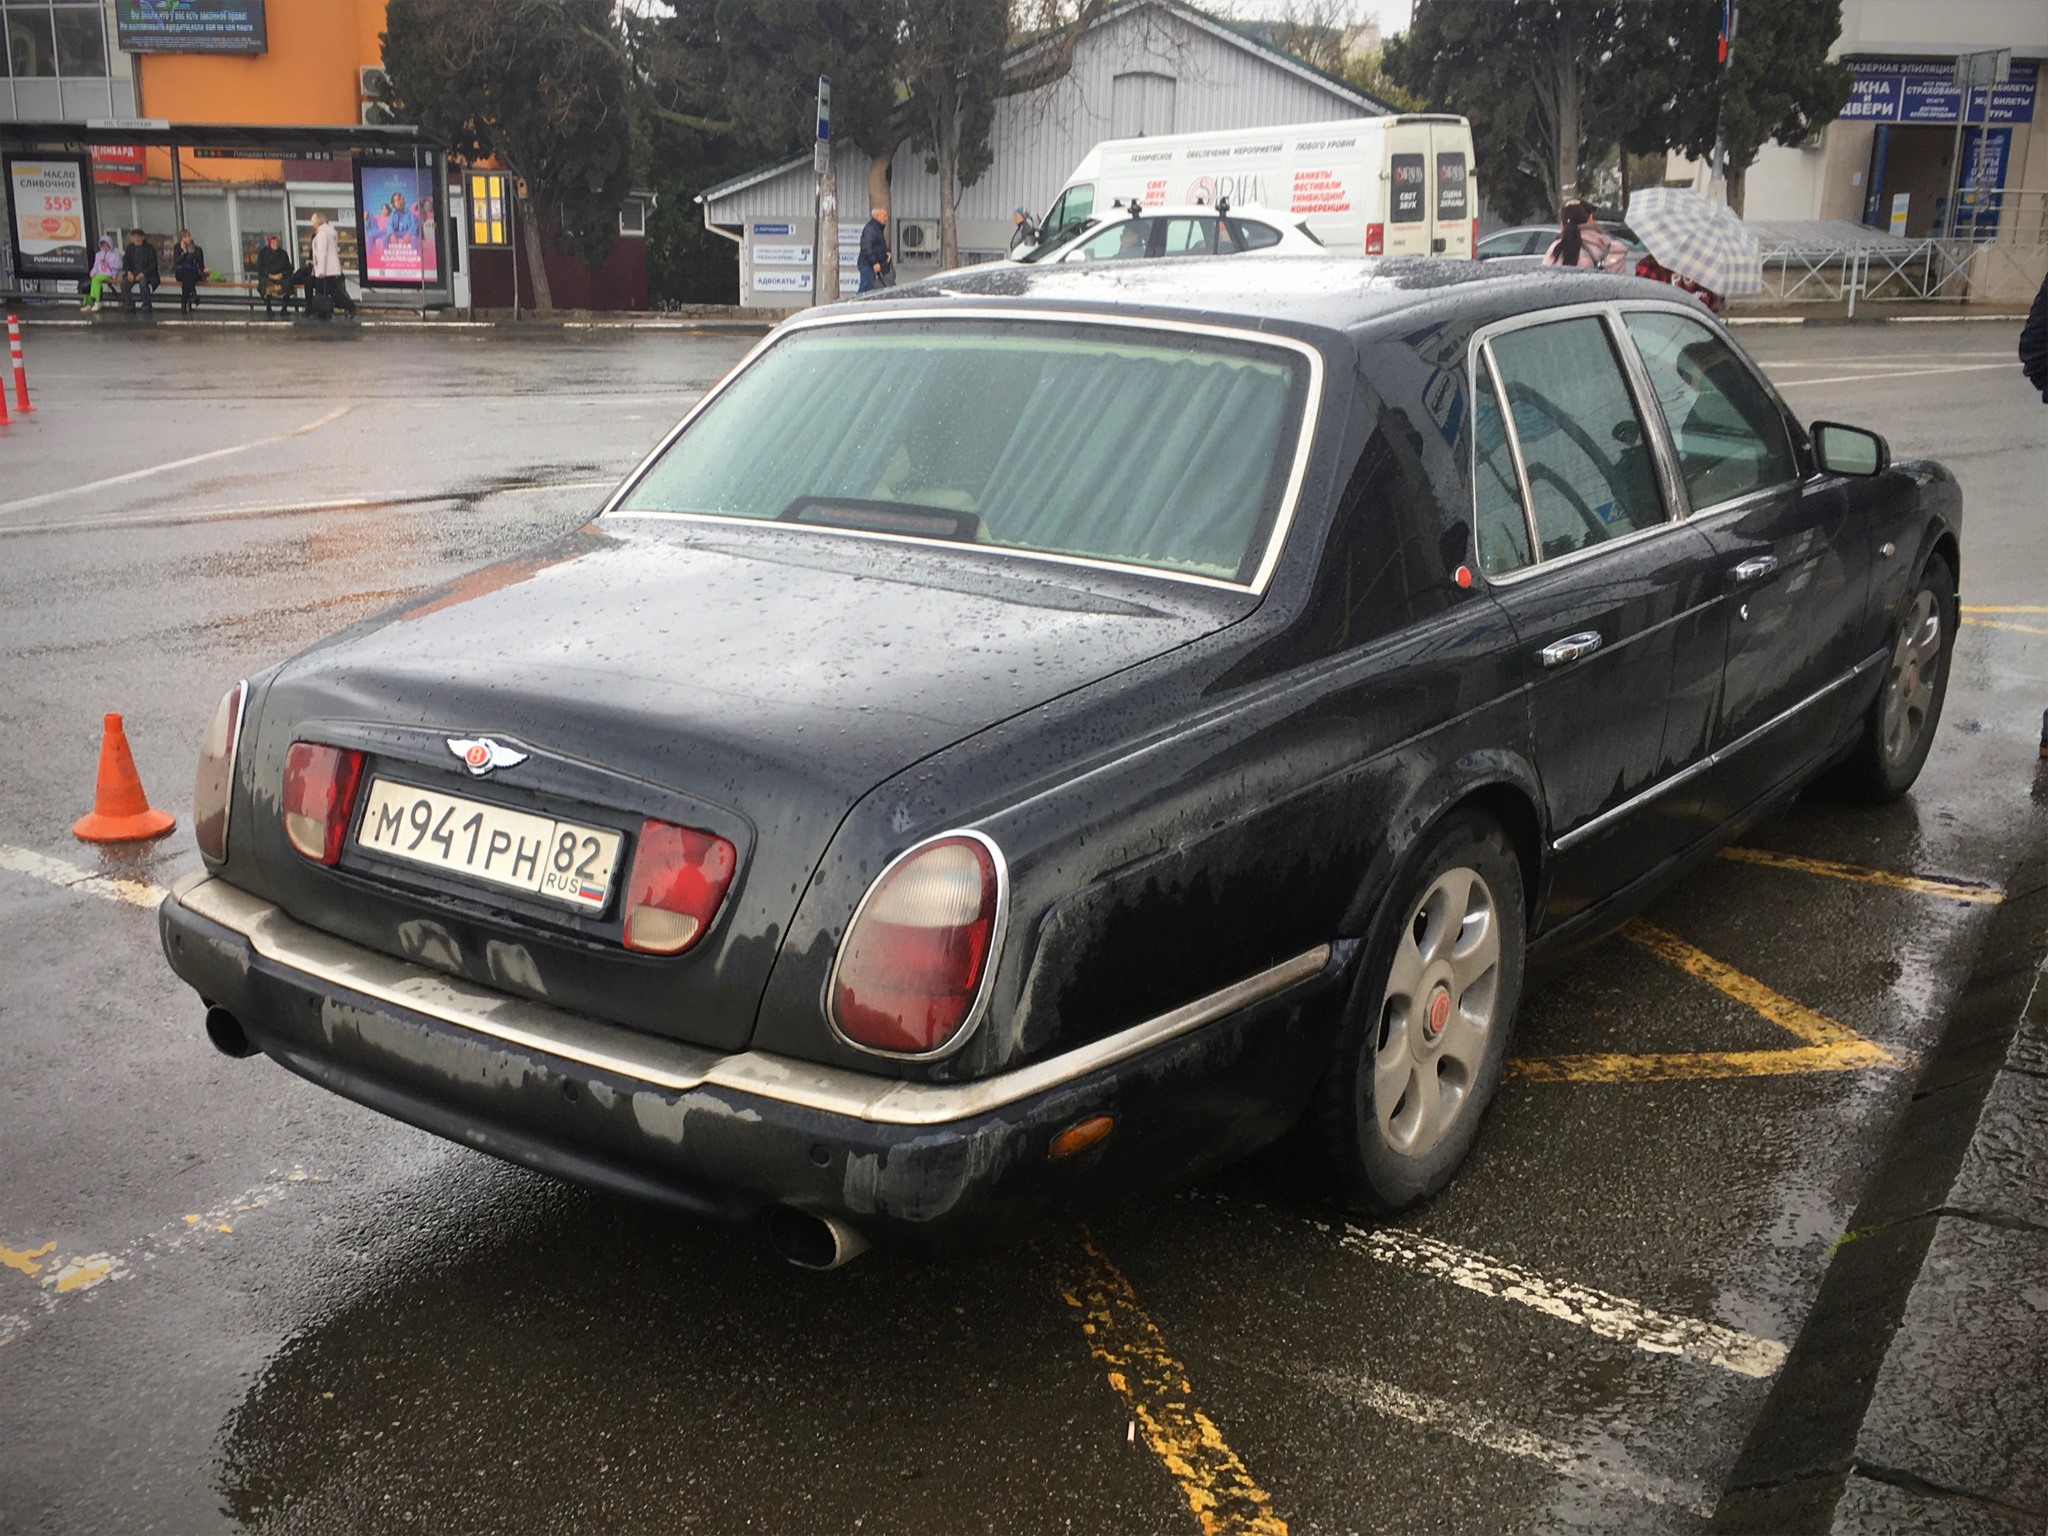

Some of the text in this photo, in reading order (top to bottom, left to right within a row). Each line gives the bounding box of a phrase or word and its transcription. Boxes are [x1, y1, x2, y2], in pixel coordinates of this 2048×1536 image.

[1846, 63, 1957, 74] ЛАЗЕРНАЯ ЭПИЛЯЦИЯ
[1906, 86, 1961, 95] СТРАХОВАНИ
[1863, 94, 1872, 102] И
[1993, 97, 2031, 105] БИЛЕТЫ
[1840, 102, 1894, 116] ДВЕРИ
[1989, 110, 2013, 118] ТУРЫ
[1131, 138, 1357, 162] ТЕХНИЧЕСКОЕ ОБЕСПЕЧЕНИЕ МЕРОПРИЯТИЙ ЛЮБОГО УРОВНЯ
[1973, 157, 2000, 167] ТРЫ
[44, 171, 76, 179] МАСЛО
[1294, 171, 1333, 181] БАНКЕТЫ
[20, 180, 77, 188] СЛИВОЧНОЕ
[1147, 180, 1167, 189] СВЕТ
[1293, 181, 1342, 191] ФЕСТИВАЛИ
[1145, 191, 1166, 199] ЗВУК
[1292, 191, 1346, 202] ТИМБИЛДИНГ
[1400, 191, 1417, 200] СВЕТ
[1442, 190, 1462, 198] СЦЕНА
[43, 195, 72, 211] 359
[1399, 200, 1417, 210] ЗВУК
[1440, 198, 1465, 207] ЭКРАНЫ
[1291, 203, 1351, 213] КОНФЕРЕНЦИИ
[469, 746, 483, 763] B
[374, 800, 542, 881] М941РН
[553, 831, 602, 880] 82
[545, 874, 579, 894] RUS
